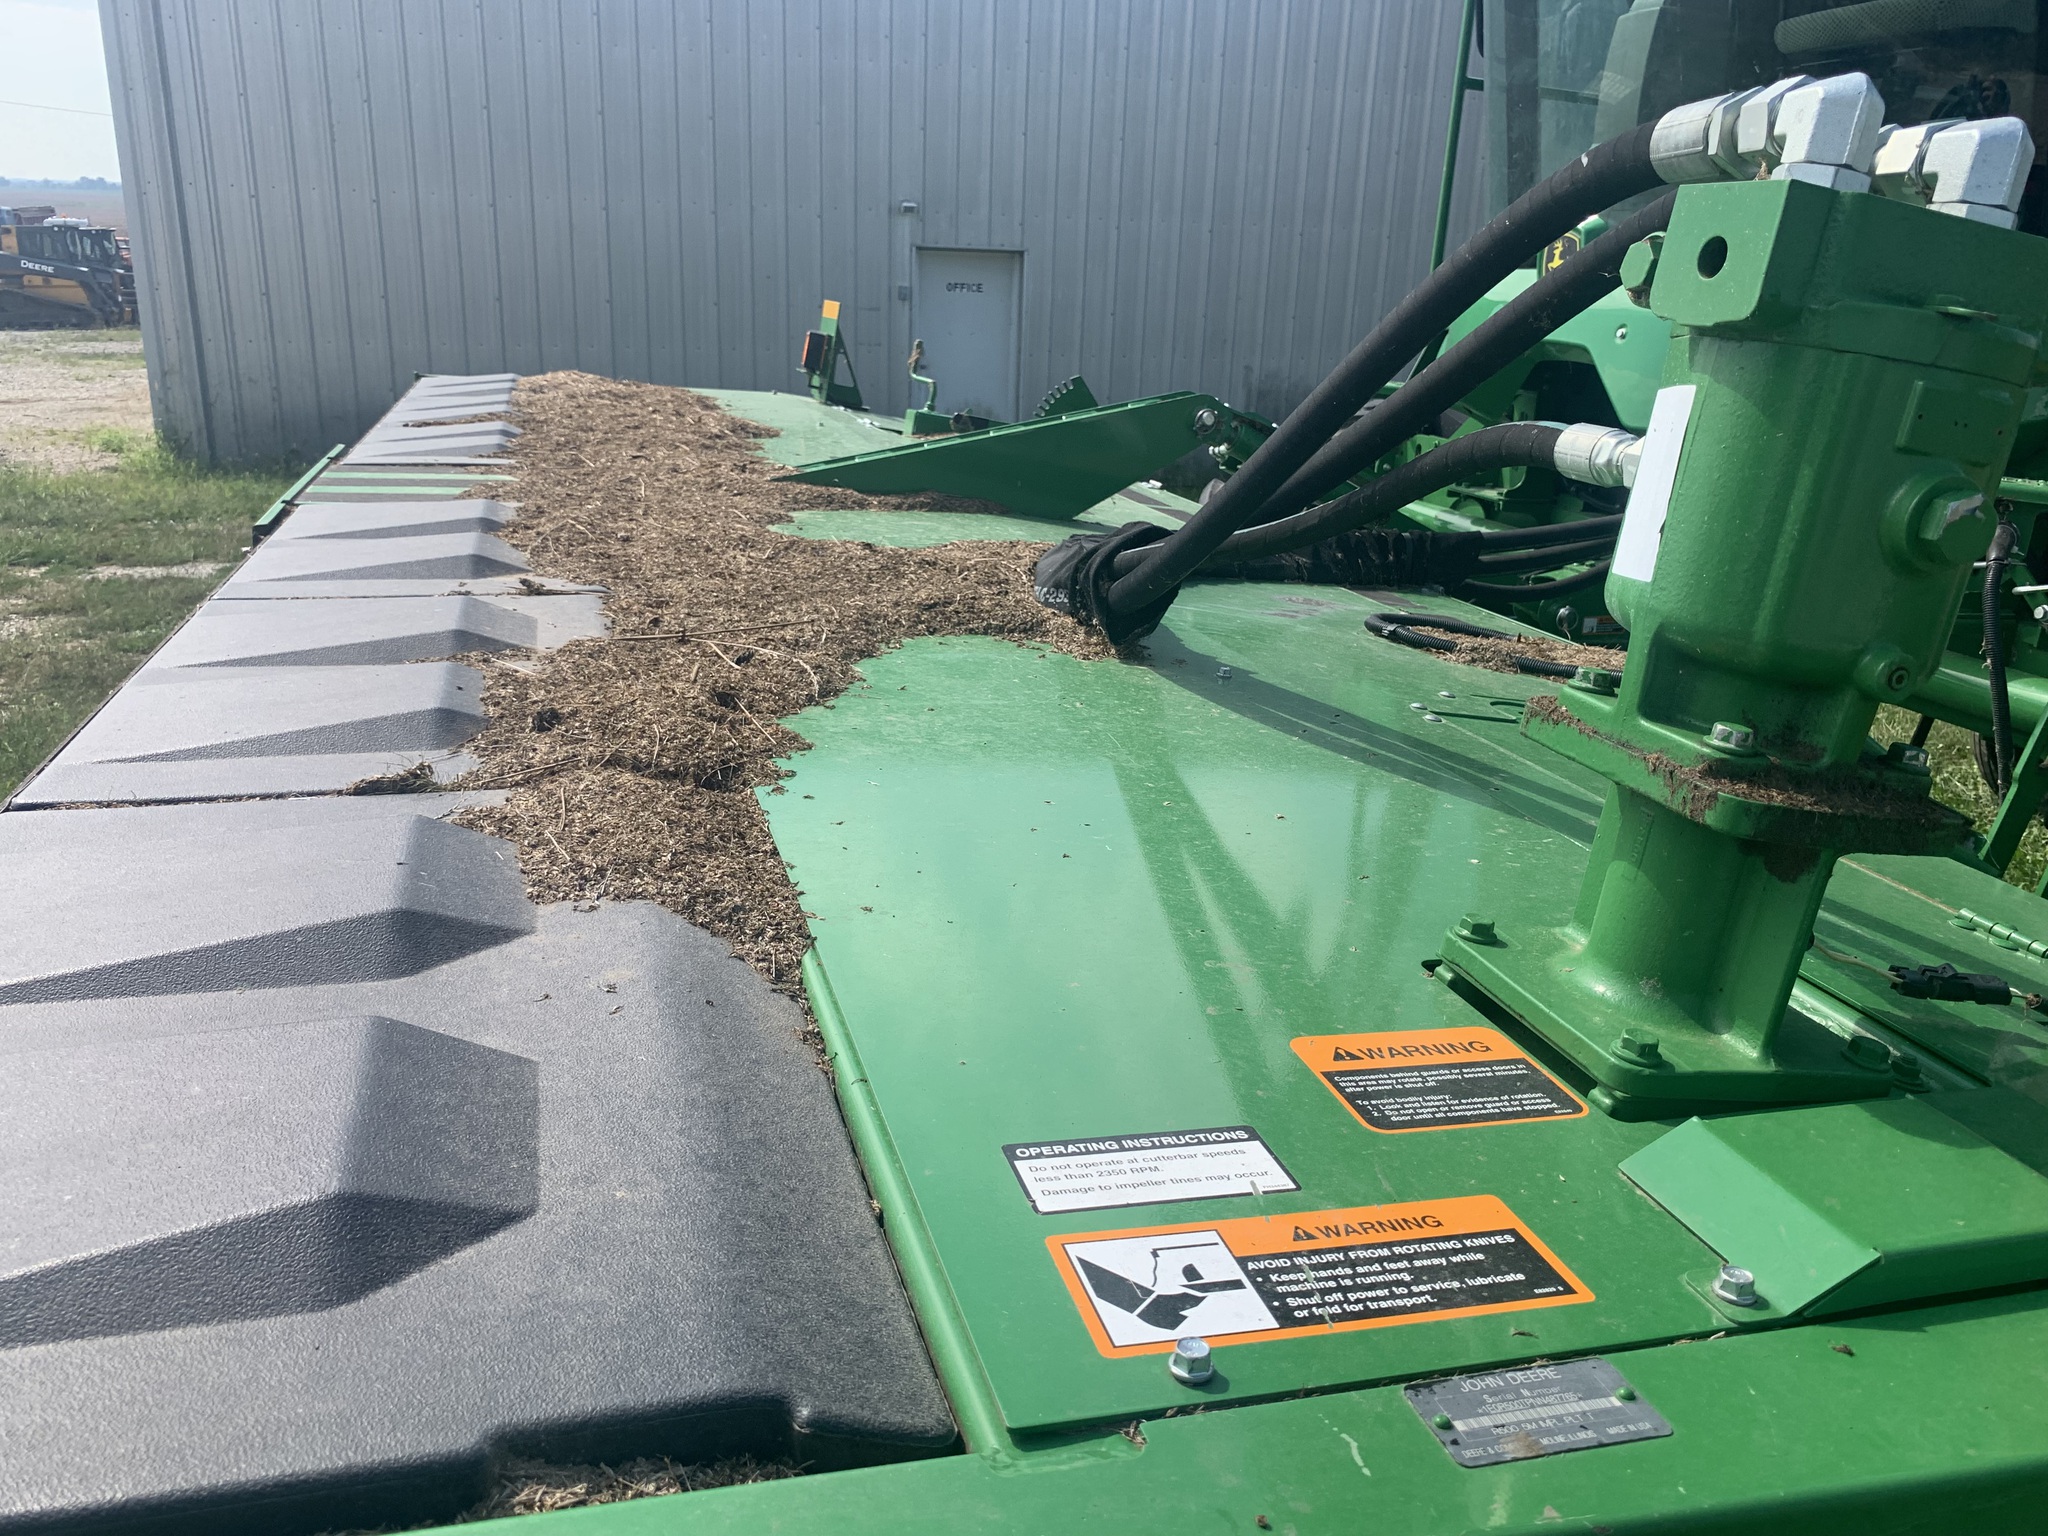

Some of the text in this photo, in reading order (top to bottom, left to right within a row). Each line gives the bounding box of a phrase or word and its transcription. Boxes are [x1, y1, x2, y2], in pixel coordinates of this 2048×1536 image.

[21, 260, 55, 273] DEERE
[946, 282, 984, 293] OFFICE
[1357, 1041, 1493, 1060] WARNING
[1334, 1073, 1389, 1082] Components
[1427, 1073, 1462, 1081] possibly
[1421, 1099, 1446, 1107] listen
[1446, 1108, 1500, 1117] components
[1523, 1102, 1560, 1110] stopped.
[1015, 1130, 1249, 1158] OPERATING INSTRUCTIONS
[1028, 1148, 1246, 1173] Do not operate at cutterbar speeds
[1064, 1172, 1093, 1181] than
[1097, 1168, 1127, 1178] 2350
[1129, 1165, 1164, 1175] RPM.
[1041, 1170, 1273, 1197] Damage to impeller tines may occur.
[1314, 1215, 1444, 1239] WARNING
[1247, 1234, 1516, 1271] AVOID INJURY FROM ROTATING KNIVES
[1269, 1252, 1485, 1282] Keep hands and feet away while
[1276, 1272, 1414, 1293] machine is running.
[1286, 1272, 1526, 1306] Shut off power to service, lubricate
[1294, 1294, 1437, 1318] or fold for transport.
[1460, 1367, 1562, 1392] JOHN DEERE
[1482, 1385, 1562, 1403] Serial Number
[1563, 1414, 1583, 1424] PLT
[1585, 1412, 1594, 1420] T
[1606, 1421, 1652, 1434] MADE IN USA
[1461, 1447, 1488, 1458] DEERE
